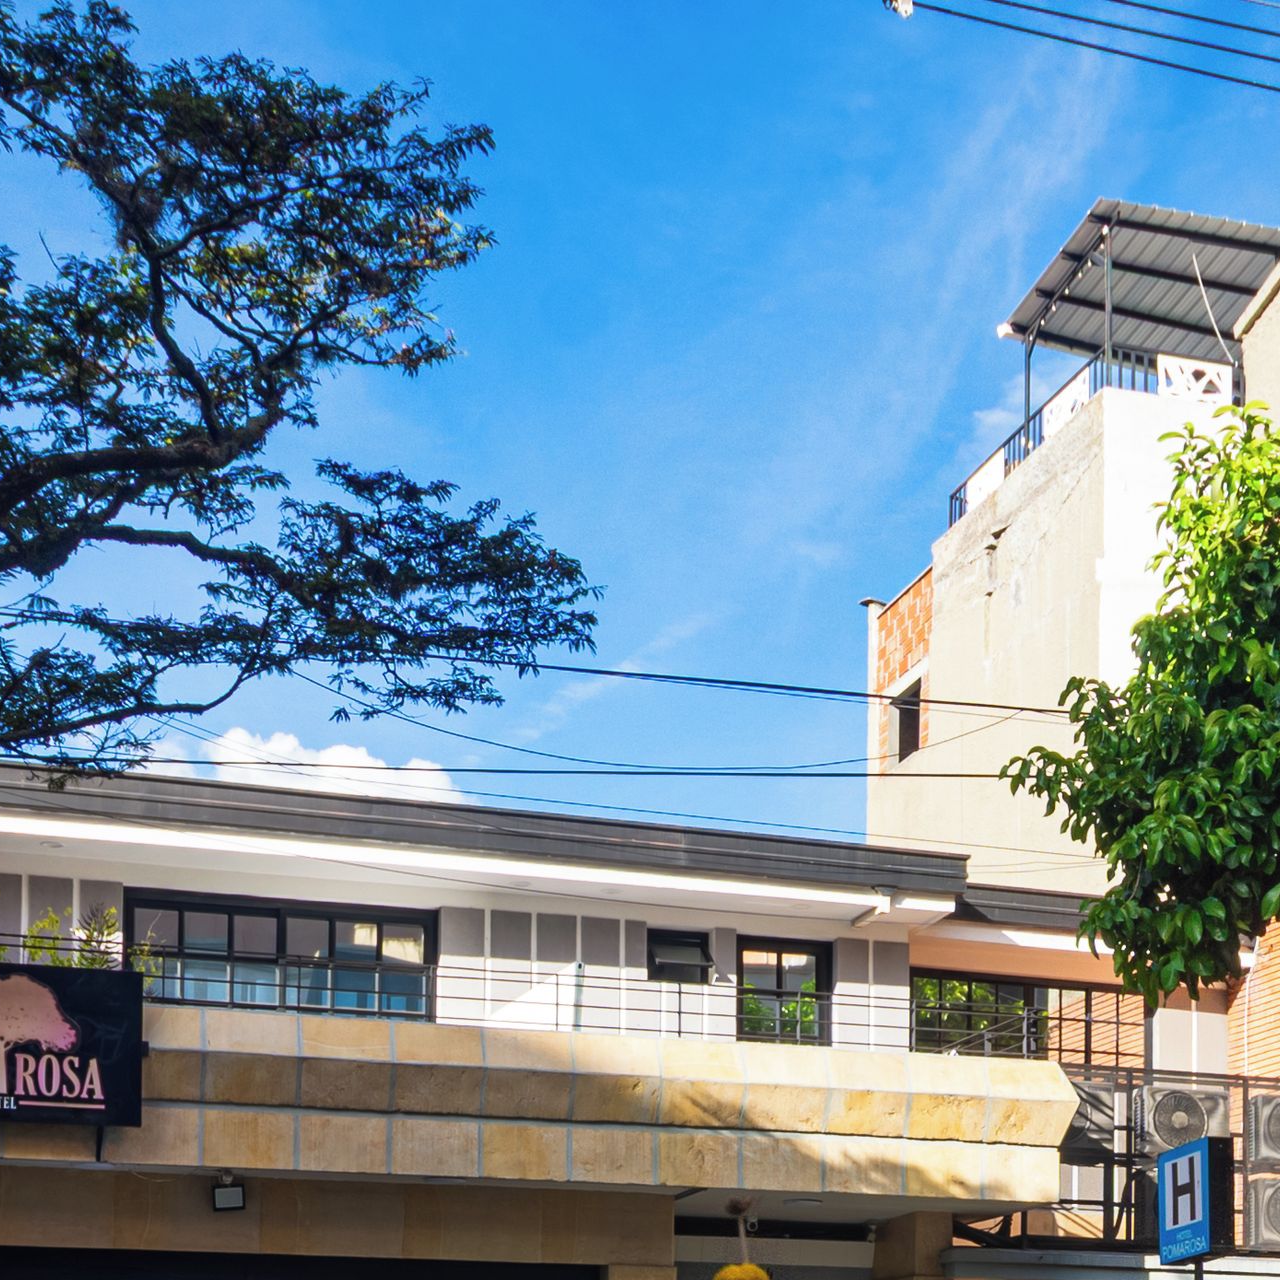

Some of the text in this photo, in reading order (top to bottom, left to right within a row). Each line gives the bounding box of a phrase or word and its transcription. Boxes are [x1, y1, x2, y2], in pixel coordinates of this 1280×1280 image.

[1171, 1155, 1196, 1226] H
[1175, 1229, 1193, 1240] HOTEL
[1162, 1235, 1207, 1258] POMAROSA
